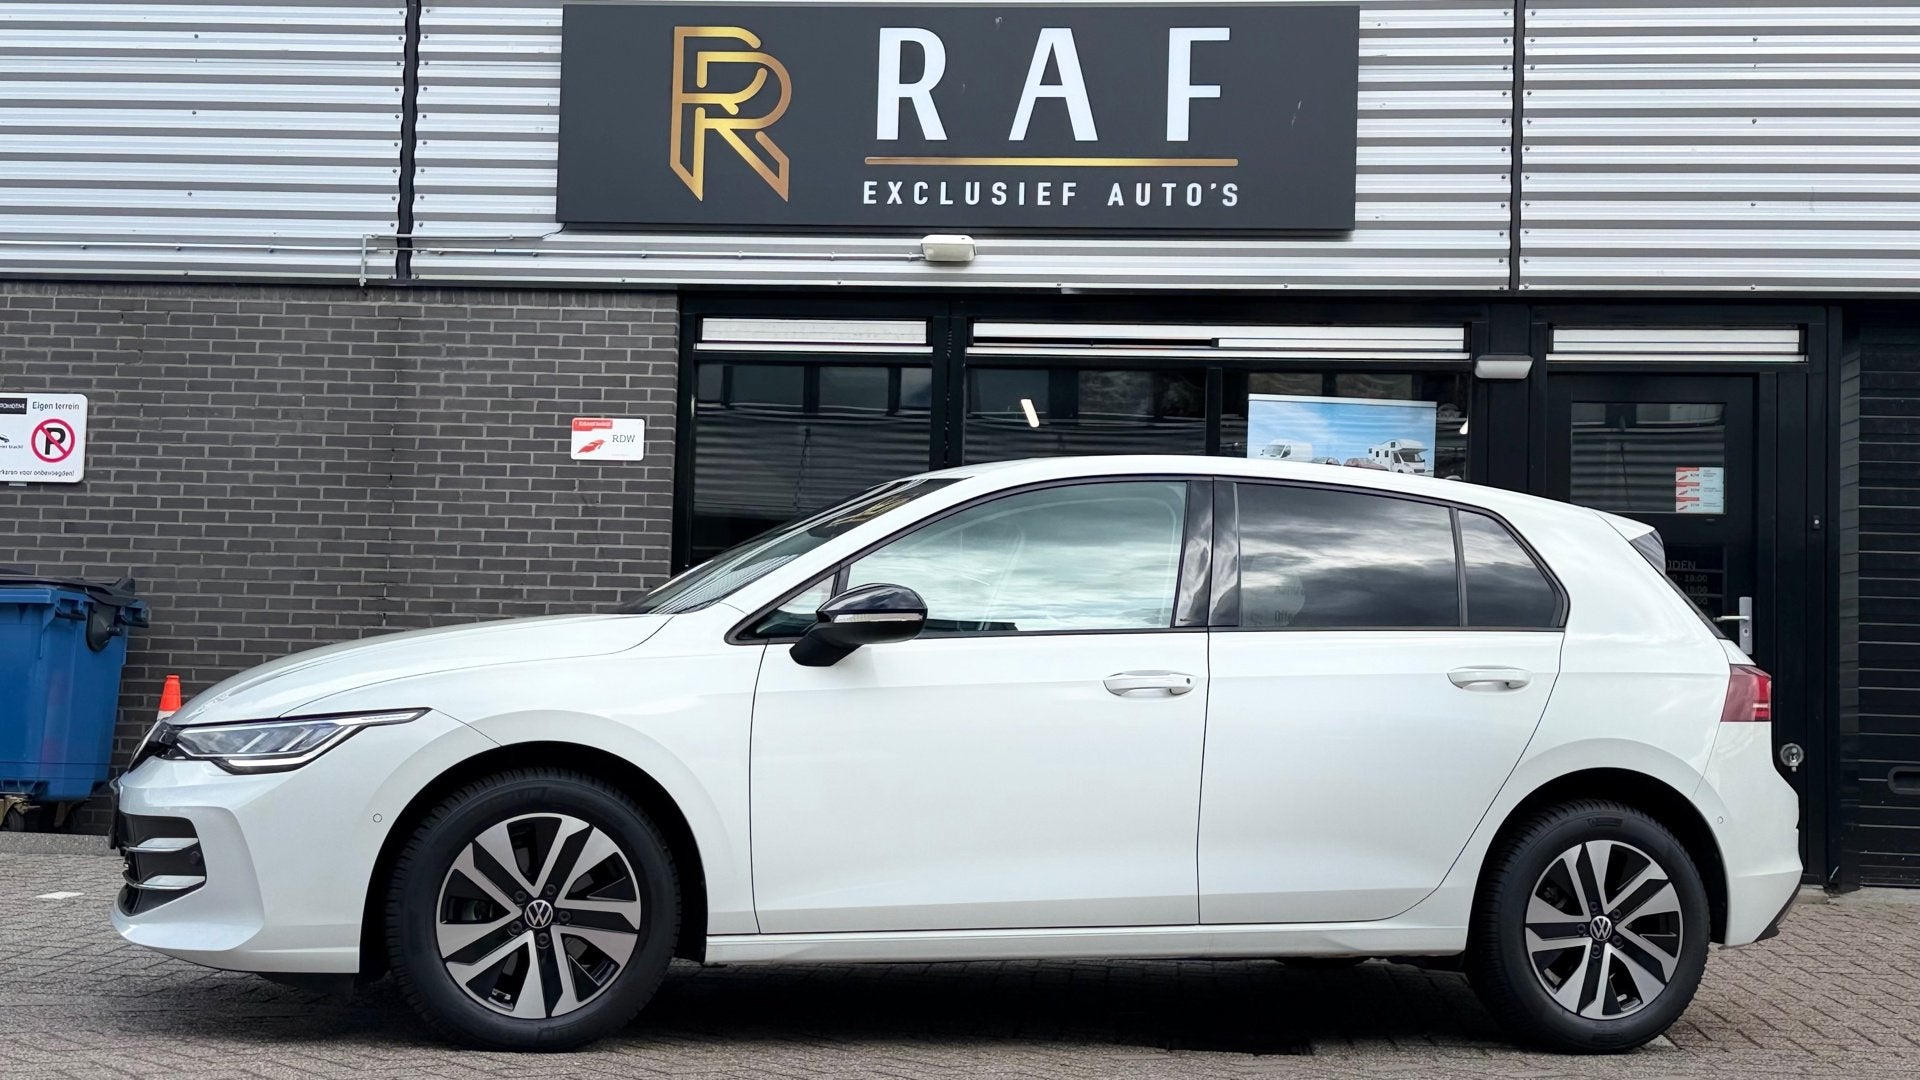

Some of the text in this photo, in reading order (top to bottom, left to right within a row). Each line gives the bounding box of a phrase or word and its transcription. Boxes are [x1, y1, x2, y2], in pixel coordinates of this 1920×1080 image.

[876, 27, 1230, 143] RAF
[863, 181, 1240, 207] EXCLUSIEF AUTO'S
[32, 402, 80, 411] Eigen terrein
[612, 434, 636, 443] RDW
